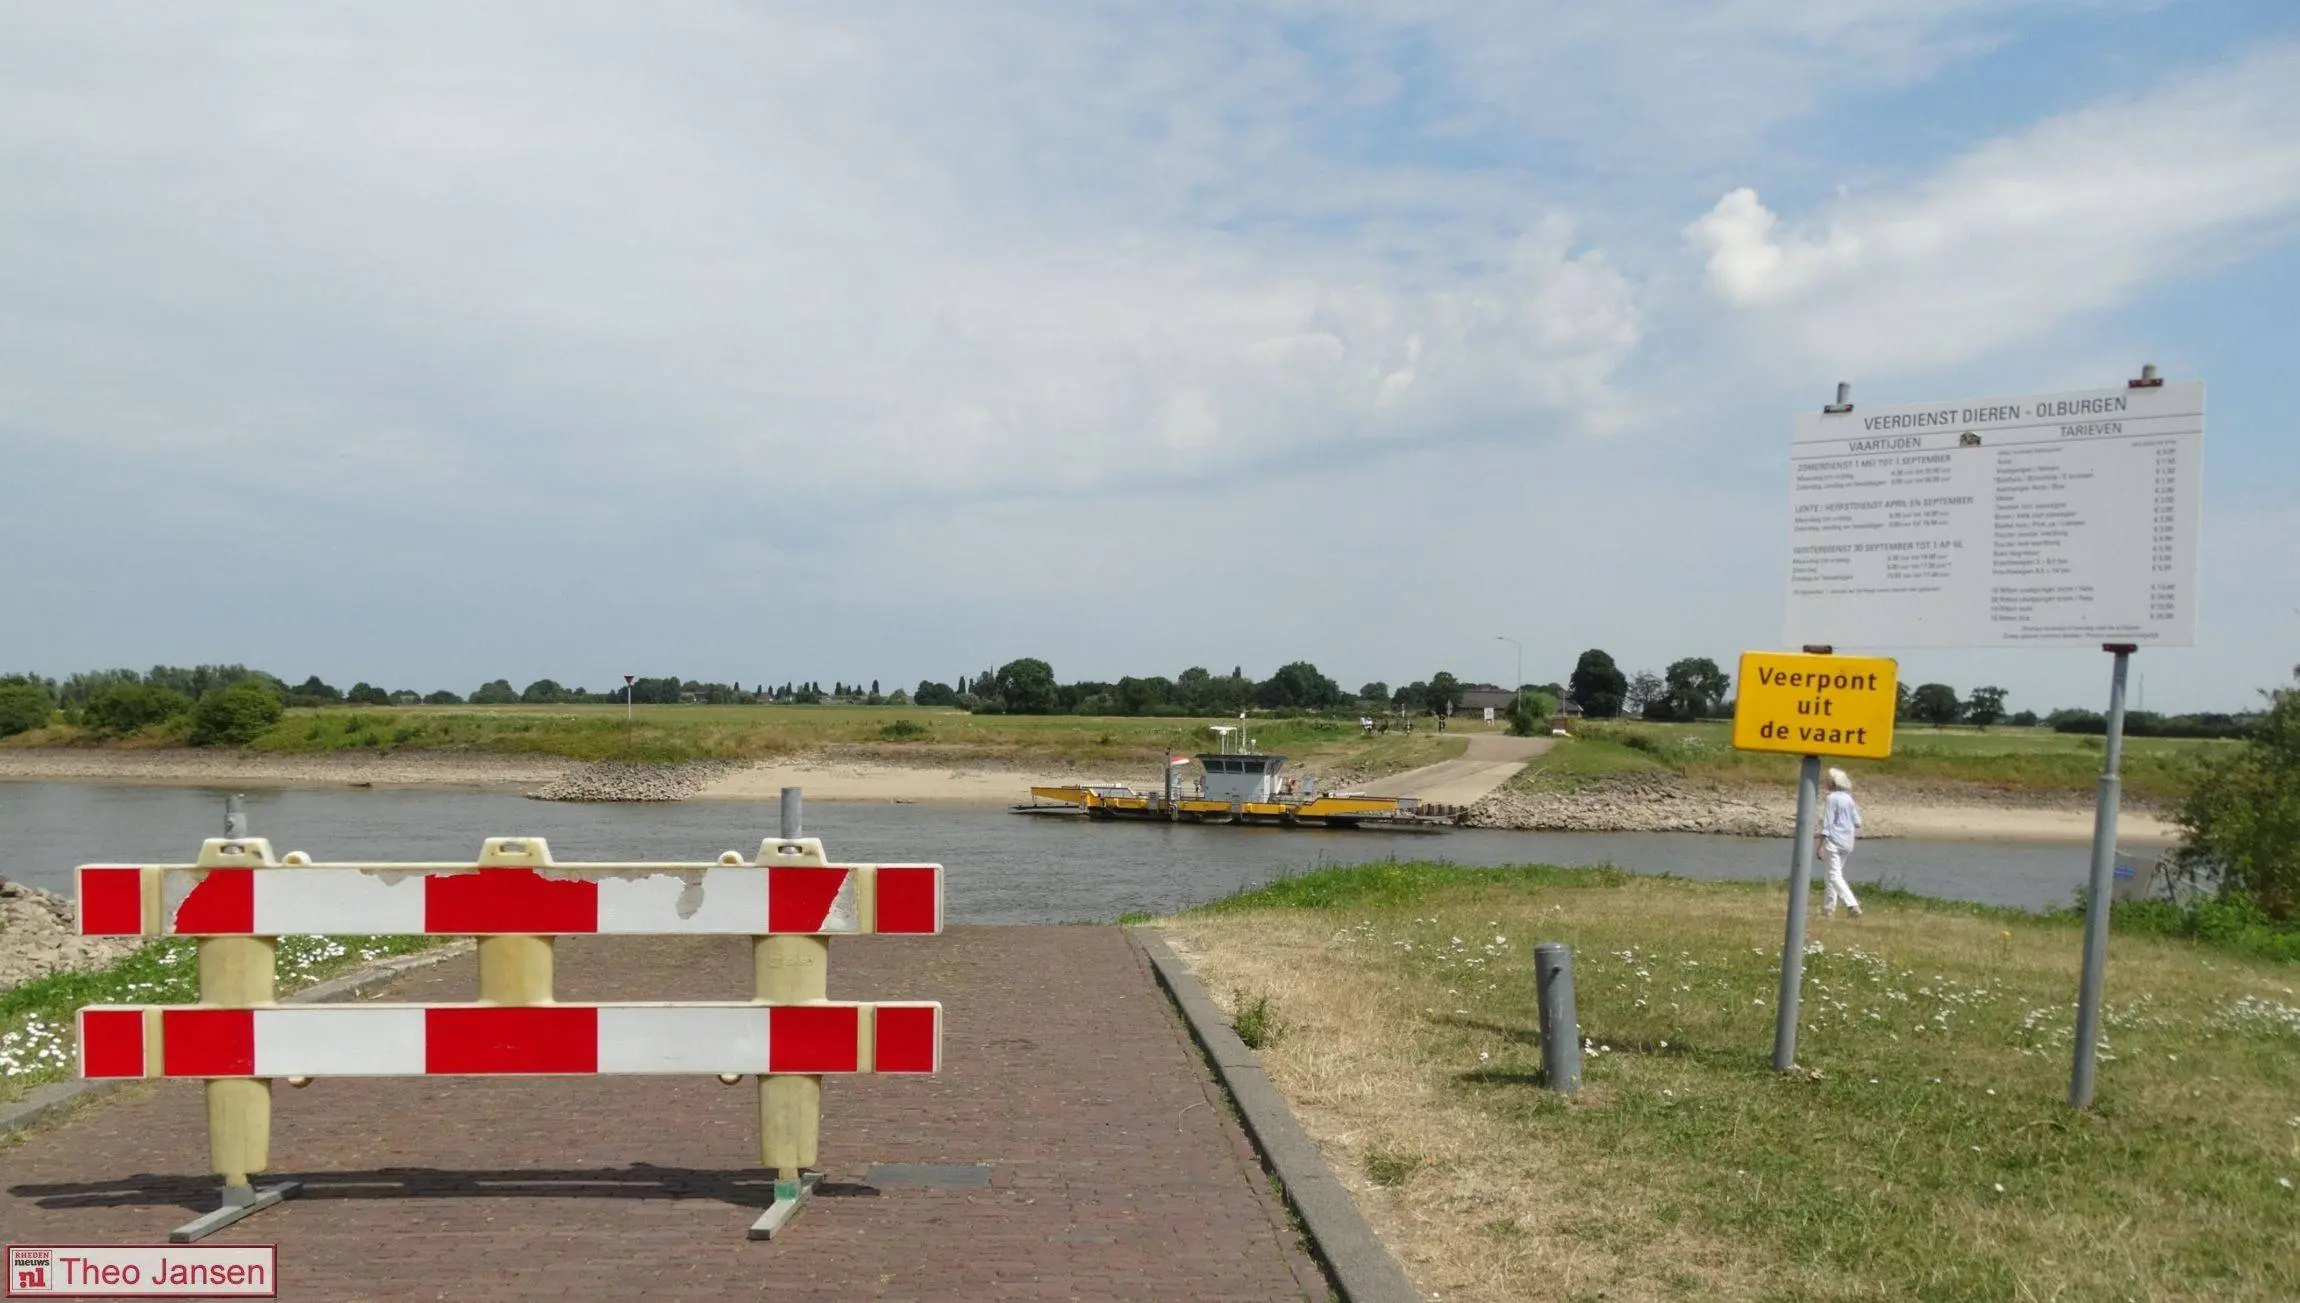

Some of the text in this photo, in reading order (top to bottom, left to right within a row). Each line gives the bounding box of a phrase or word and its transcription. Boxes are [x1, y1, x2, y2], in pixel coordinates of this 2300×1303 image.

[1863, 410, 1958, 431] VEERDIENST
[1962, 404, 2020, 424] DIEREN
[2036, 396, 2127, 418] OLBURGEN
[2060, 422, 2123, 437] TARIEVEN
[1849, 437, 1922, 452] VAARTIJDEN
[1878, 458, 1894, 468] TOT
[1901, 454, 1952, 466] SEPTEMBER
[1758, 666, 1878, 693] Veerpont
[1797, 696, 1834, 717] uit
[1760, 721, 1867, 745] de vaart
